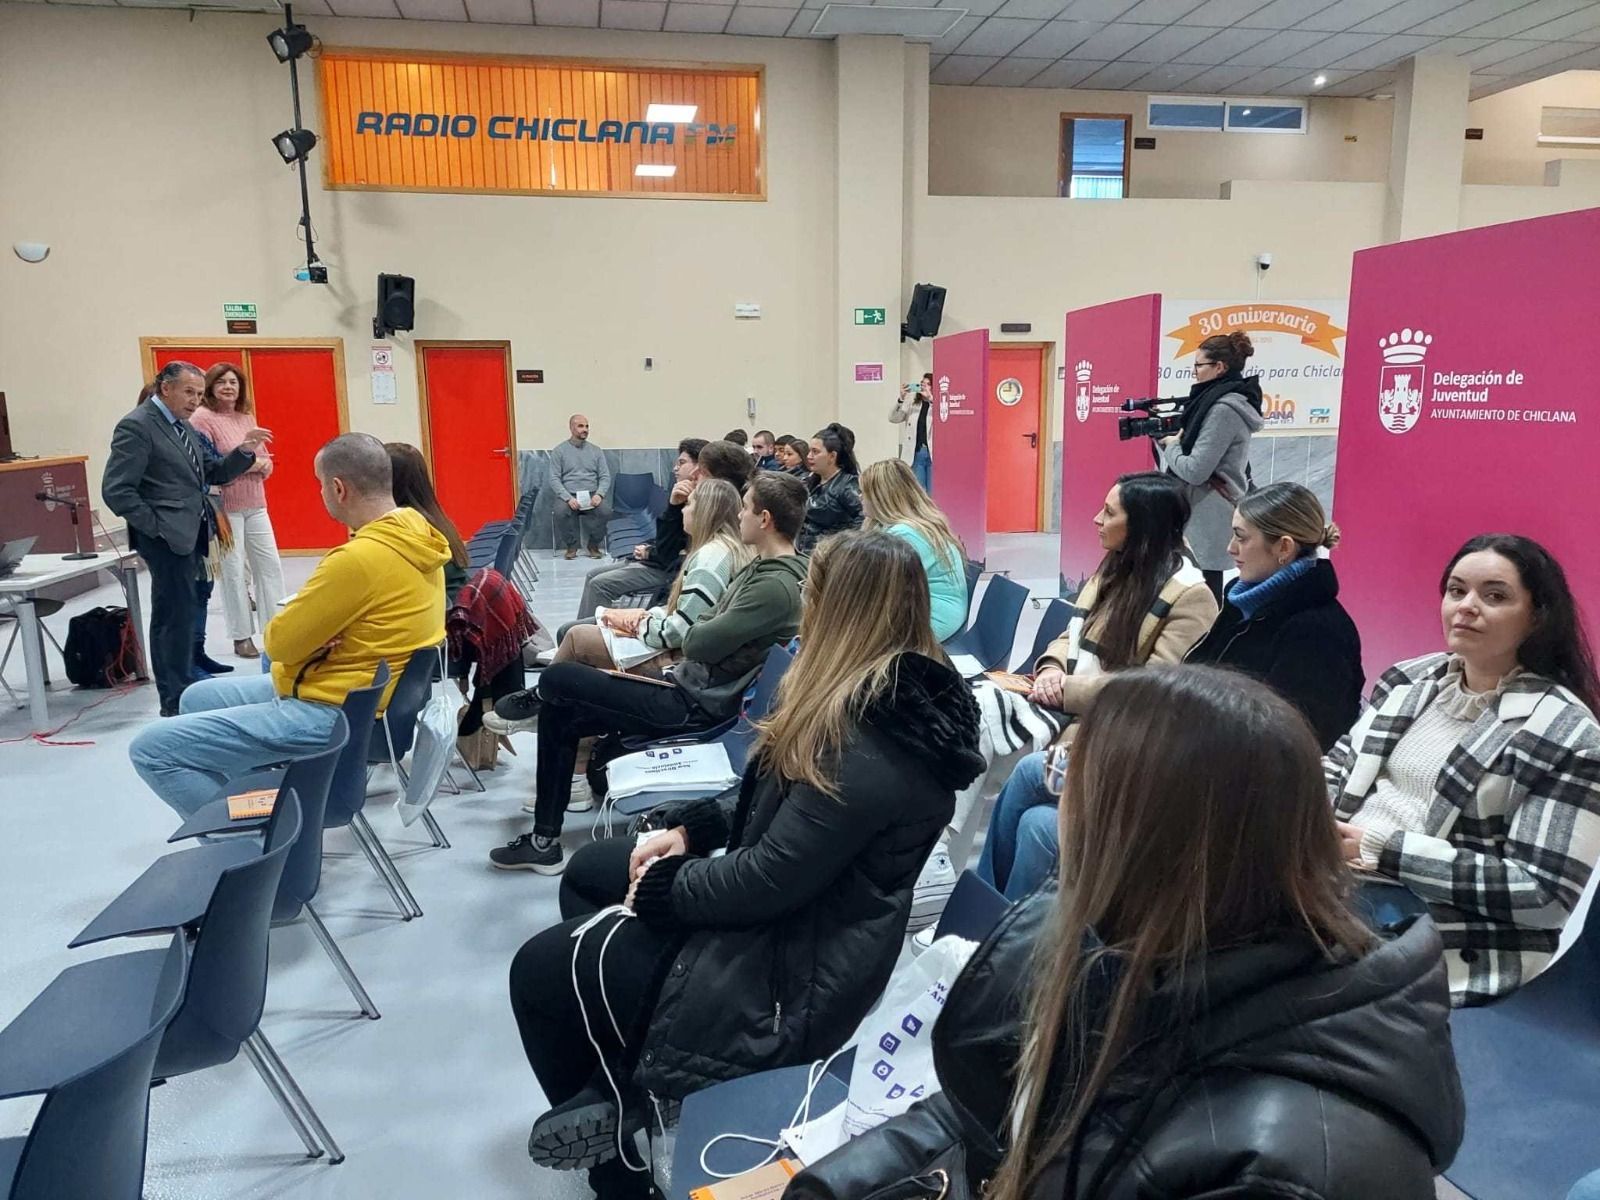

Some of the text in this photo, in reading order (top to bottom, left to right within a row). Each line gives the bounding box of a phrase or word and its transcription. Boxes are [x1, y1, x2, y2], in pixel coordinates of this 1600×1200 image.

[356, 111, 477, 138] RADIO
[487, 116, 676, 144] CHICLANA
[1198, 306, 1317, 335] 30 aniversario
[1268, 368, 1299, 381] para
[1303, 364, 1344, 378] Chicla
[1433, 369, 1524, 388] Delegación de
[1430, 388, 1488, 402] Juventud
[1430, 408, 1577, 422] AYUNTAMIENTO DE CHICLANA
